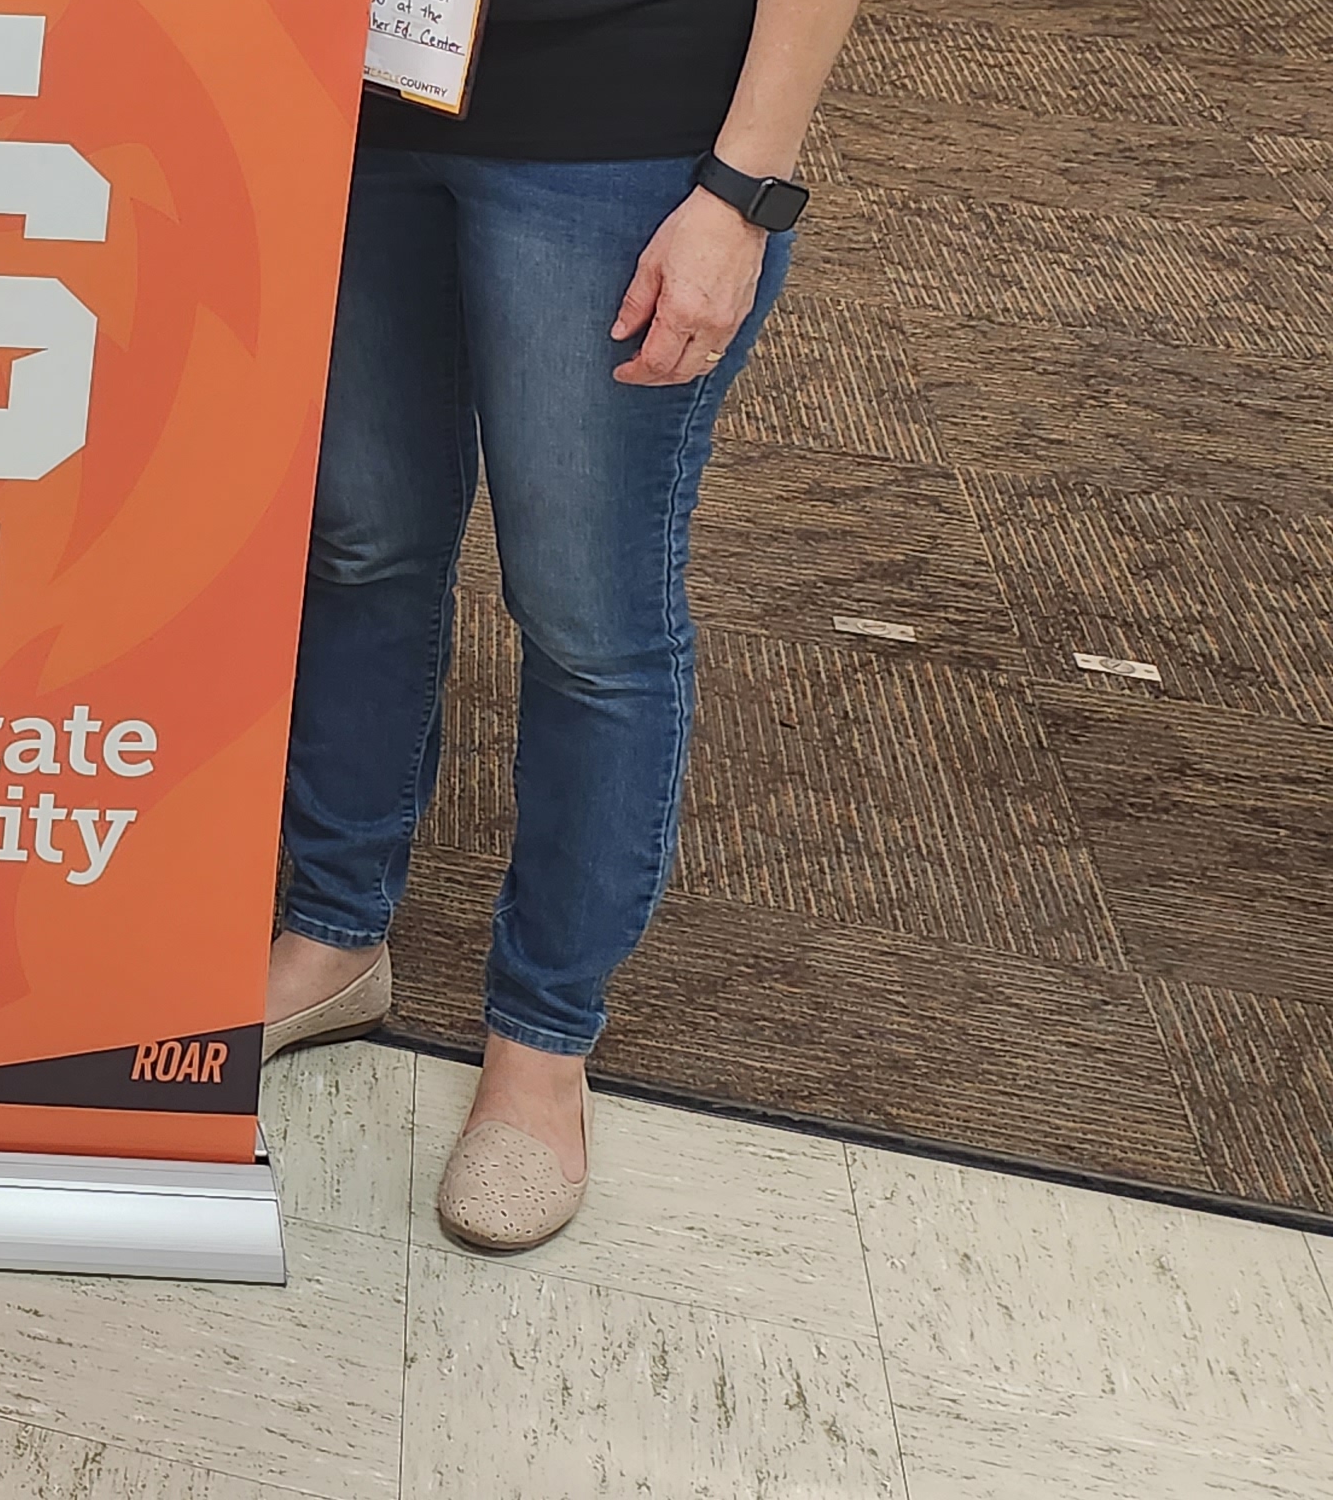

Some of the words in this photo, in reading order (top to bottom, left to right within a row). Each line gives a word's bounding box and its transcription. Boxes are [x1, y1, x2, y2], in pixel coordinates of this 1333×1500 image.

[397, 0, 413, 14] at
[420, 4, 443, 25] the
[420, 28, 462, 54] Center
[131, 1040, 229, 1085] ROAR
